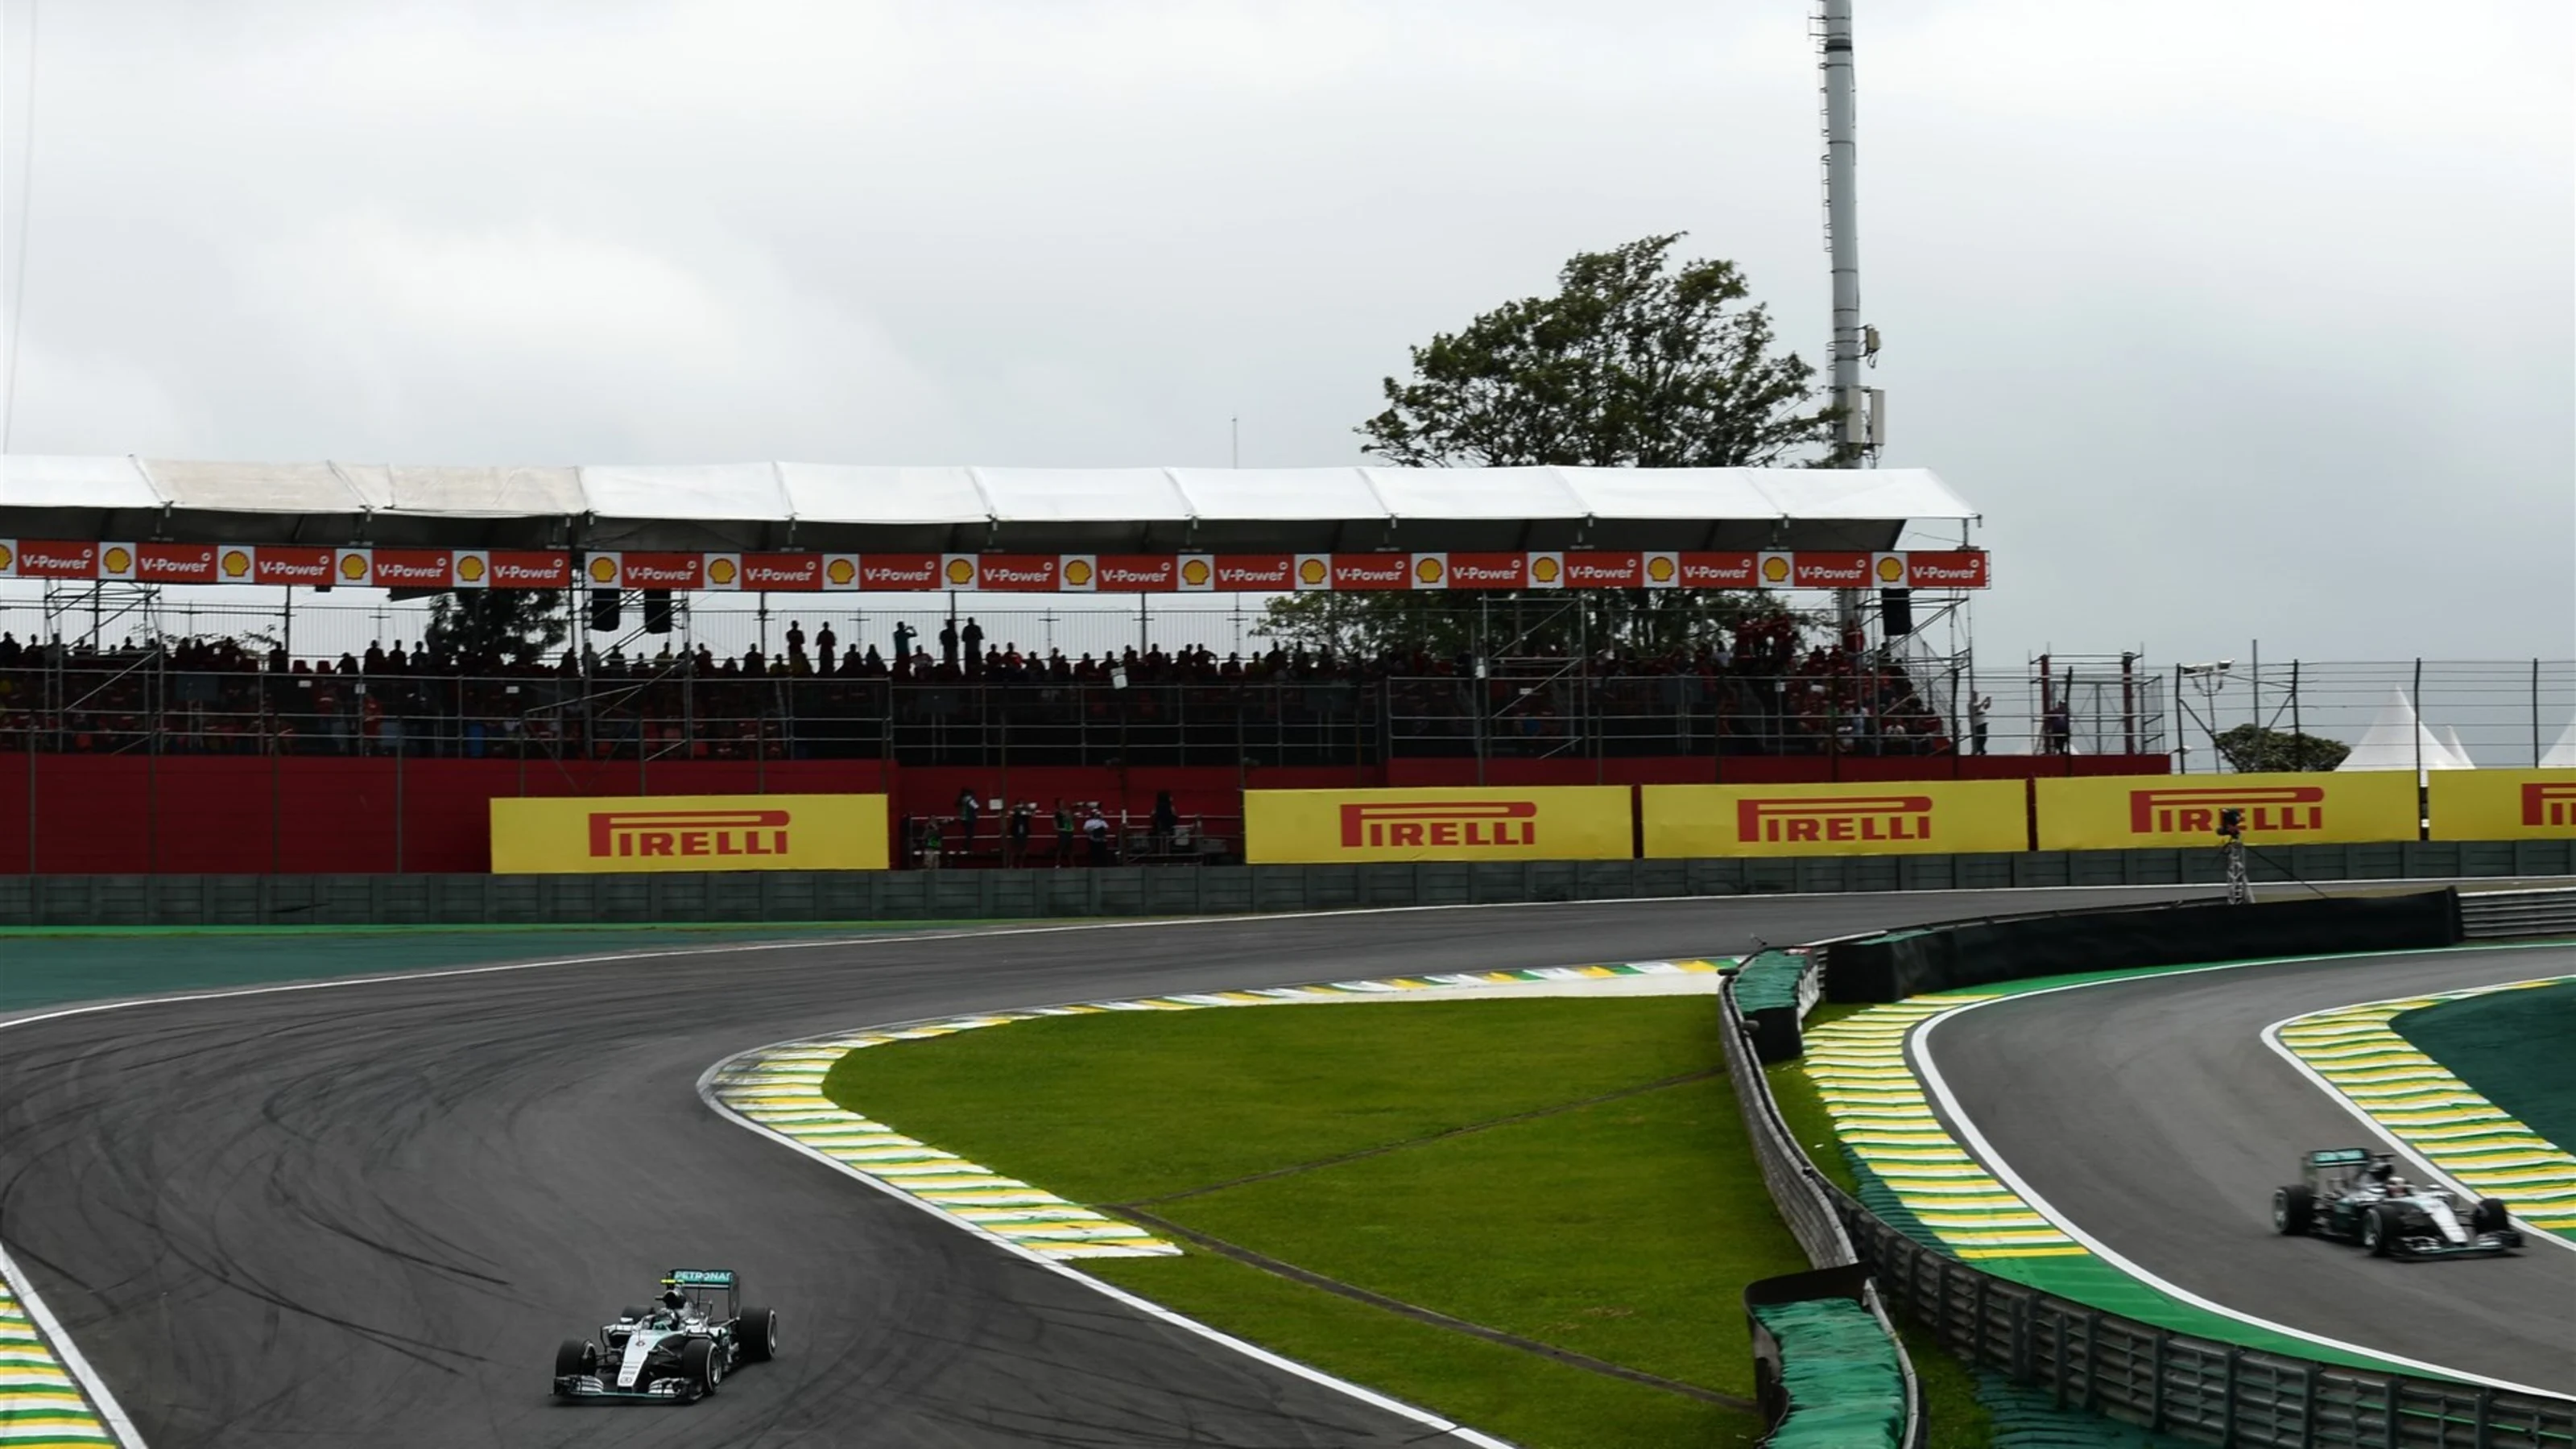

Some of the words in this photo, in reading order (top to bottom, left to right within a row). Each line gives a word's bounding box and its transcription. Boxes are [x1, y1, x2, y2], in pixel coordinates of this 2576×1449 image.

[22, 554, 89, 570] V-Power
[140, 557, 209, 572] V-Power
[258, 560, 327, 576] V-Power
[376, 564, 444, 578] V-Power
[493, 565, 560, 580] V-Power
[626, 567, 694, 581] V-Power
[746, 568, 813, 581] V-Power
[864, 568, 932, 582] V-Power
[982, 568, 1050, 582] V-Power
[1101, 568, 1168, 583] V-Power
[1219, 568, 1286, 582] V-Power
[1335, 568, 1403, 581] V-Power
[1452, 566, 1519, 580] V-Power
[1569, 565, 1634, 579] V-Power
[1683, 565, 1749, 579] V-Power
[1798, 565, 1863, 579] V-Power
[1912, 565, 1978, 579] V-Power
[1342, 803, 1536, 846] PIRELLI
[1738, 796, 1932, 841] PIRELLI
[589, 811, 790, 856] PIRELLI
